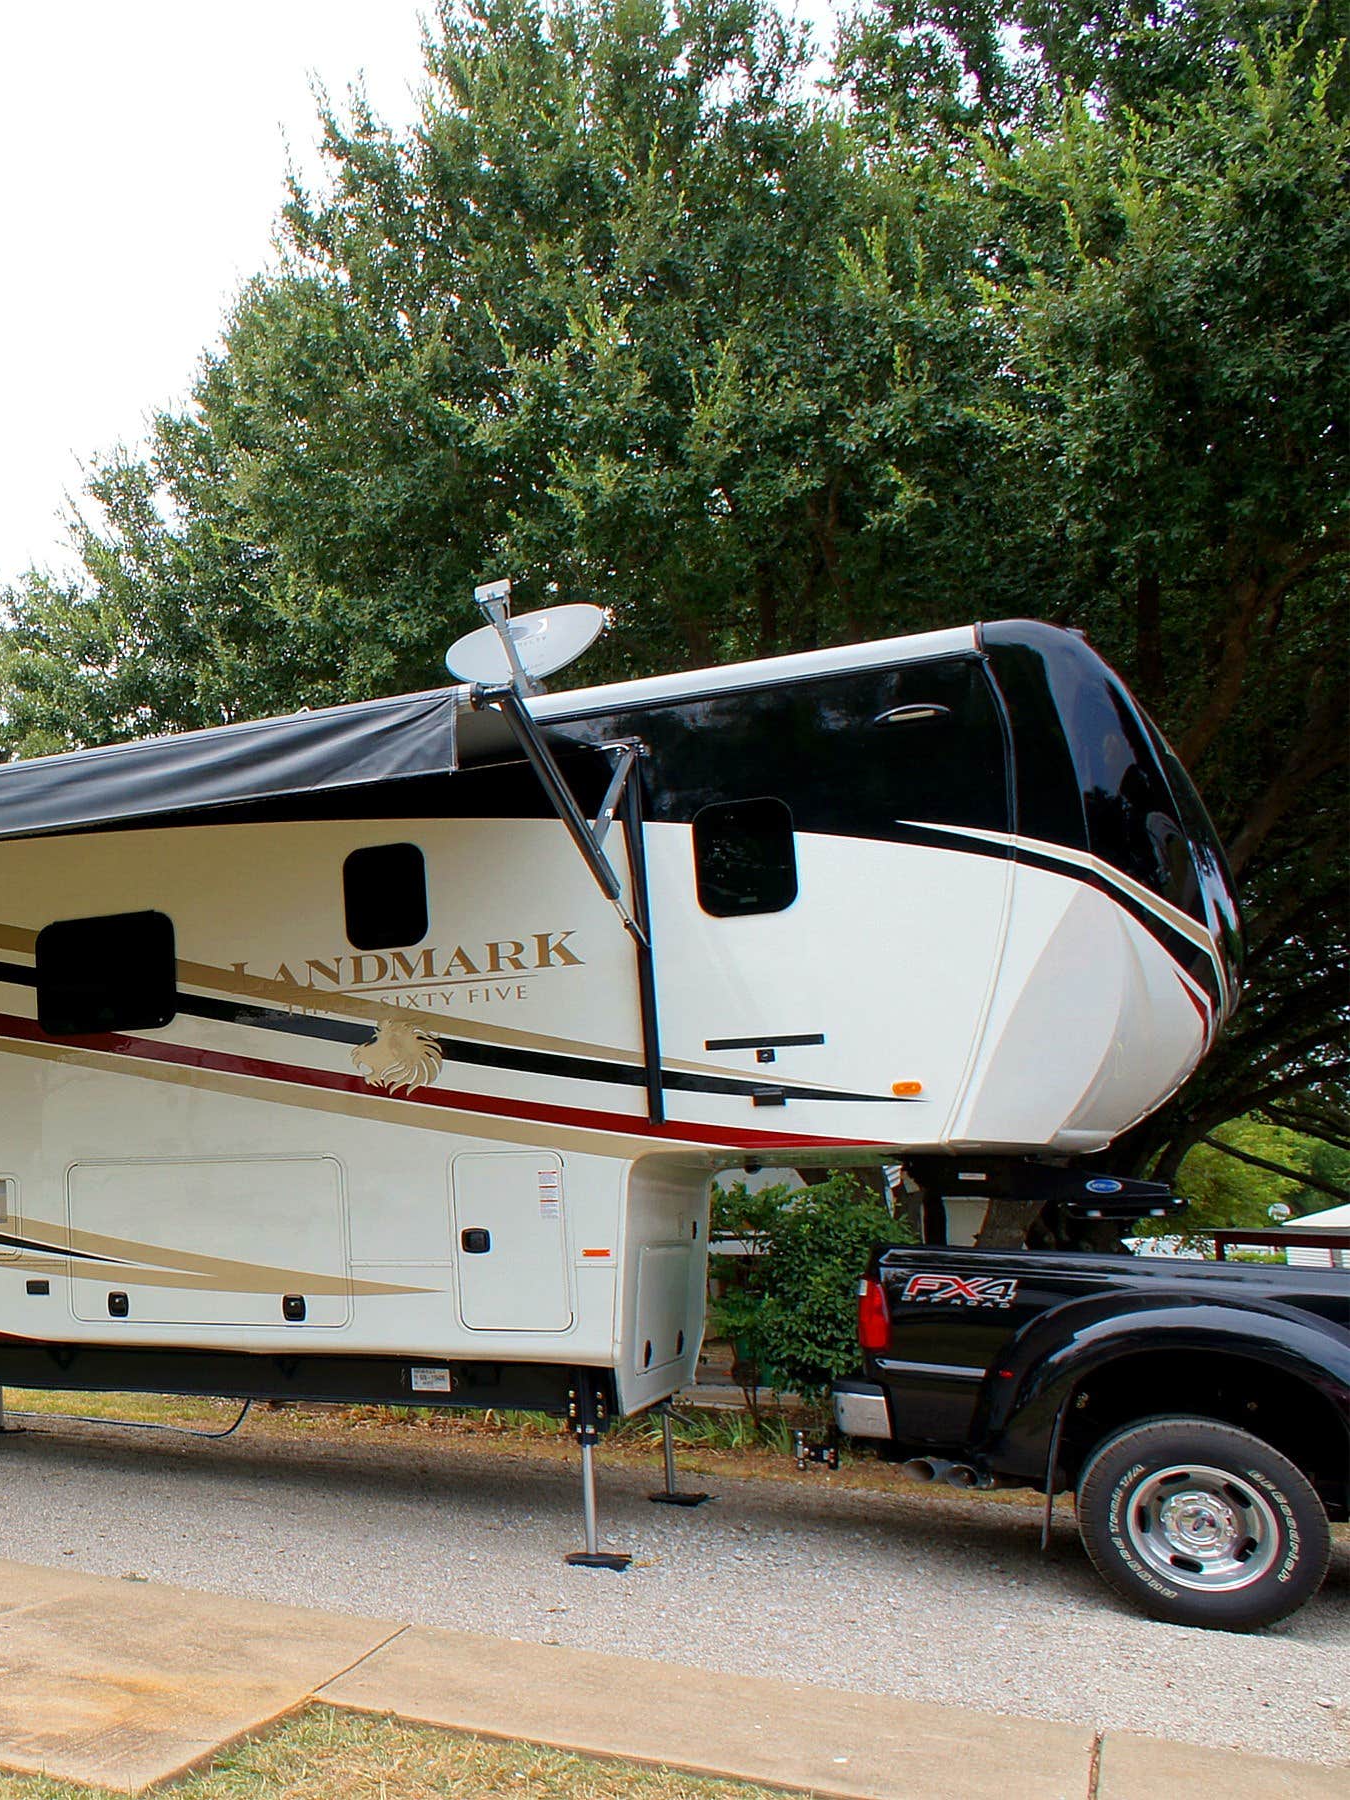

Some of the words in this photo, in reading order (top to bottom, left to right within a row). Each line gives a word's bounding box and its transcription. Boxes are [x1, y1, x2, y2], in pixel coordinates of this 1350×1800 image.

[230, 930, 586, 994] LANDMARK
[379, 991, 454, 1010] SIXTY
[468, 984, 527, 1003] FIVE
[904, 1273, 1017, 1303] FX4
[950, 1298, 1011, 1309] ROAD
